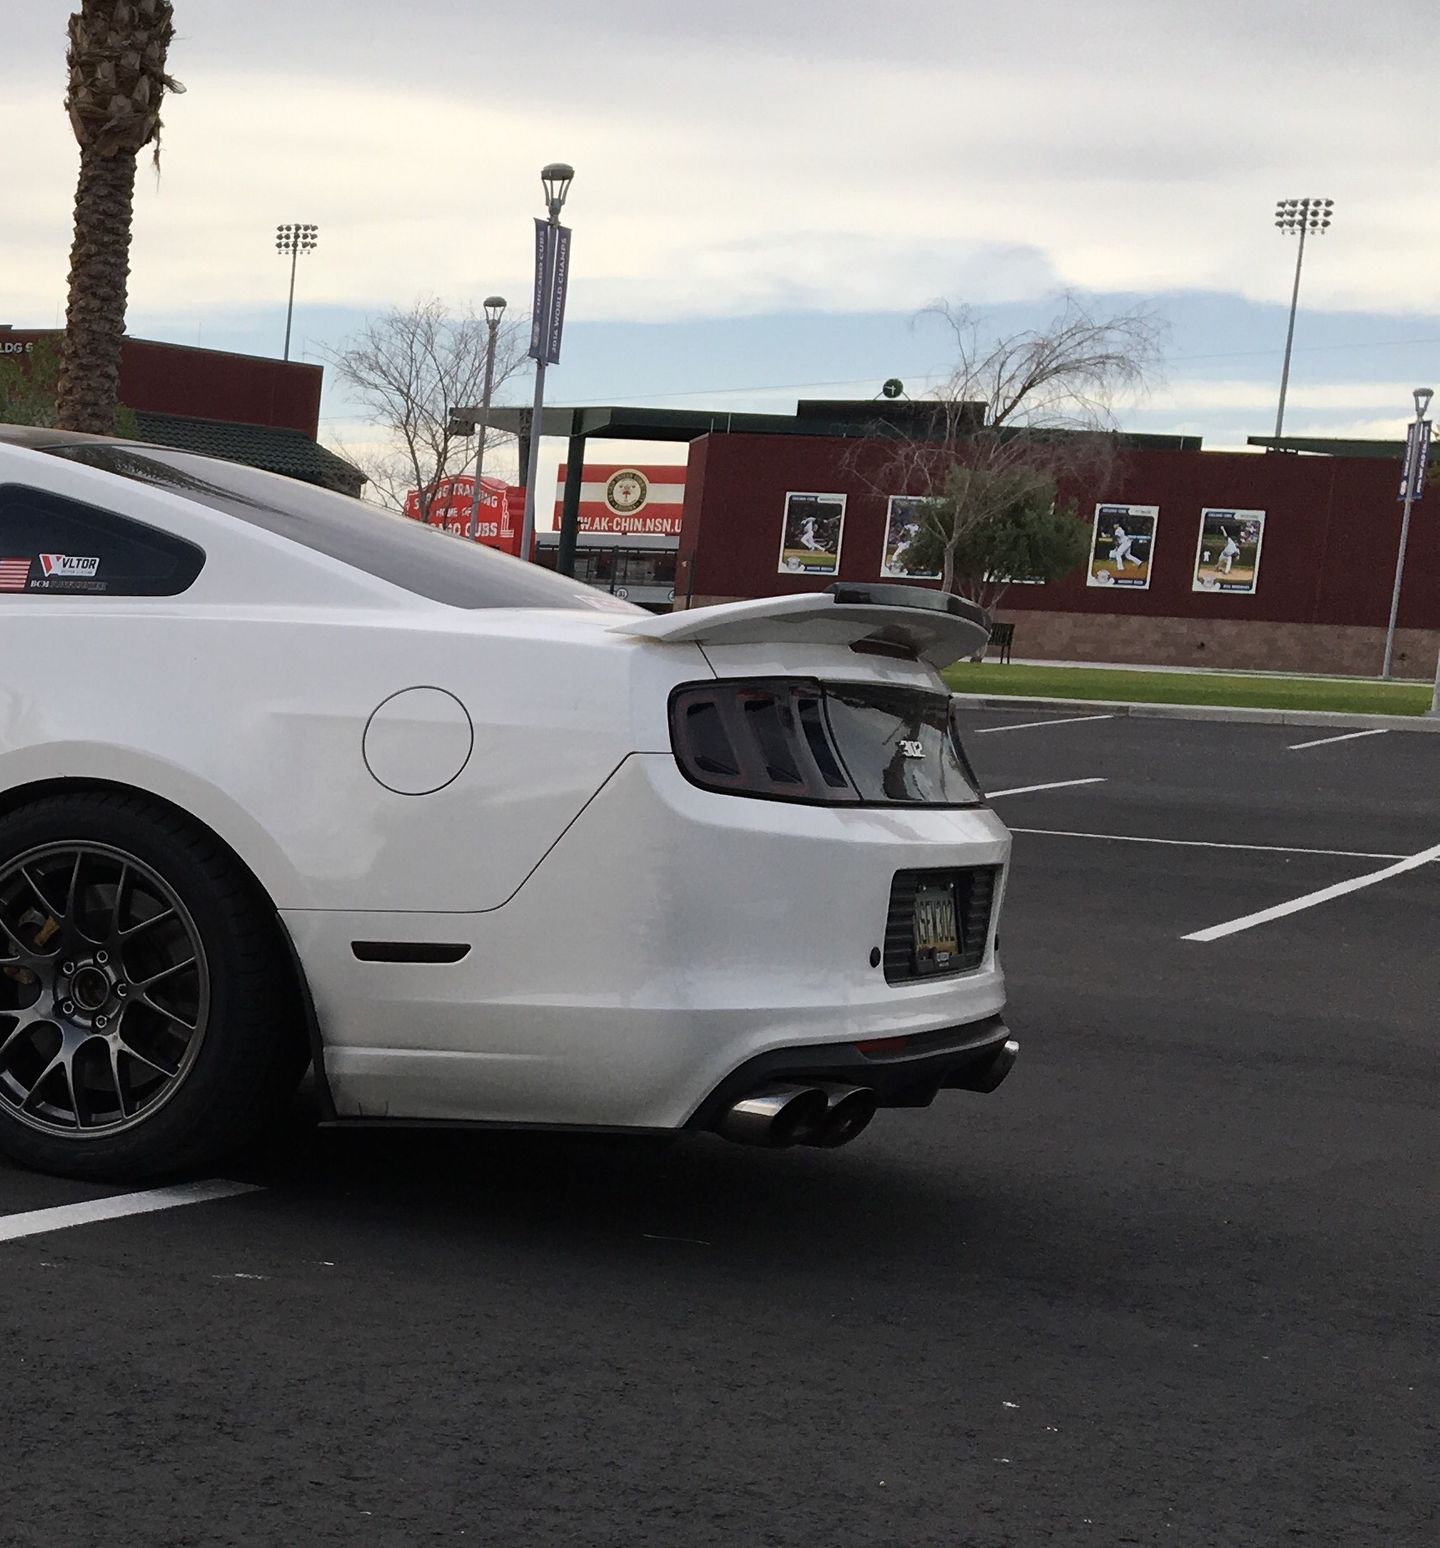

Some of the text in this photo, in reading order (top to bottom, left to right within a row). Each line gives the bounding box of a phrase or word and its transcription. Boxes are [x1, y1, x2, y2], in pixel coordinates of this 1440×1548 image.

[553, 287, 563, 327] WORLD
[558, 238, 567, 285] CHAMPS
[63, 557, 97, 569] VLTOR
[30, 579, 50, 588] BCM
